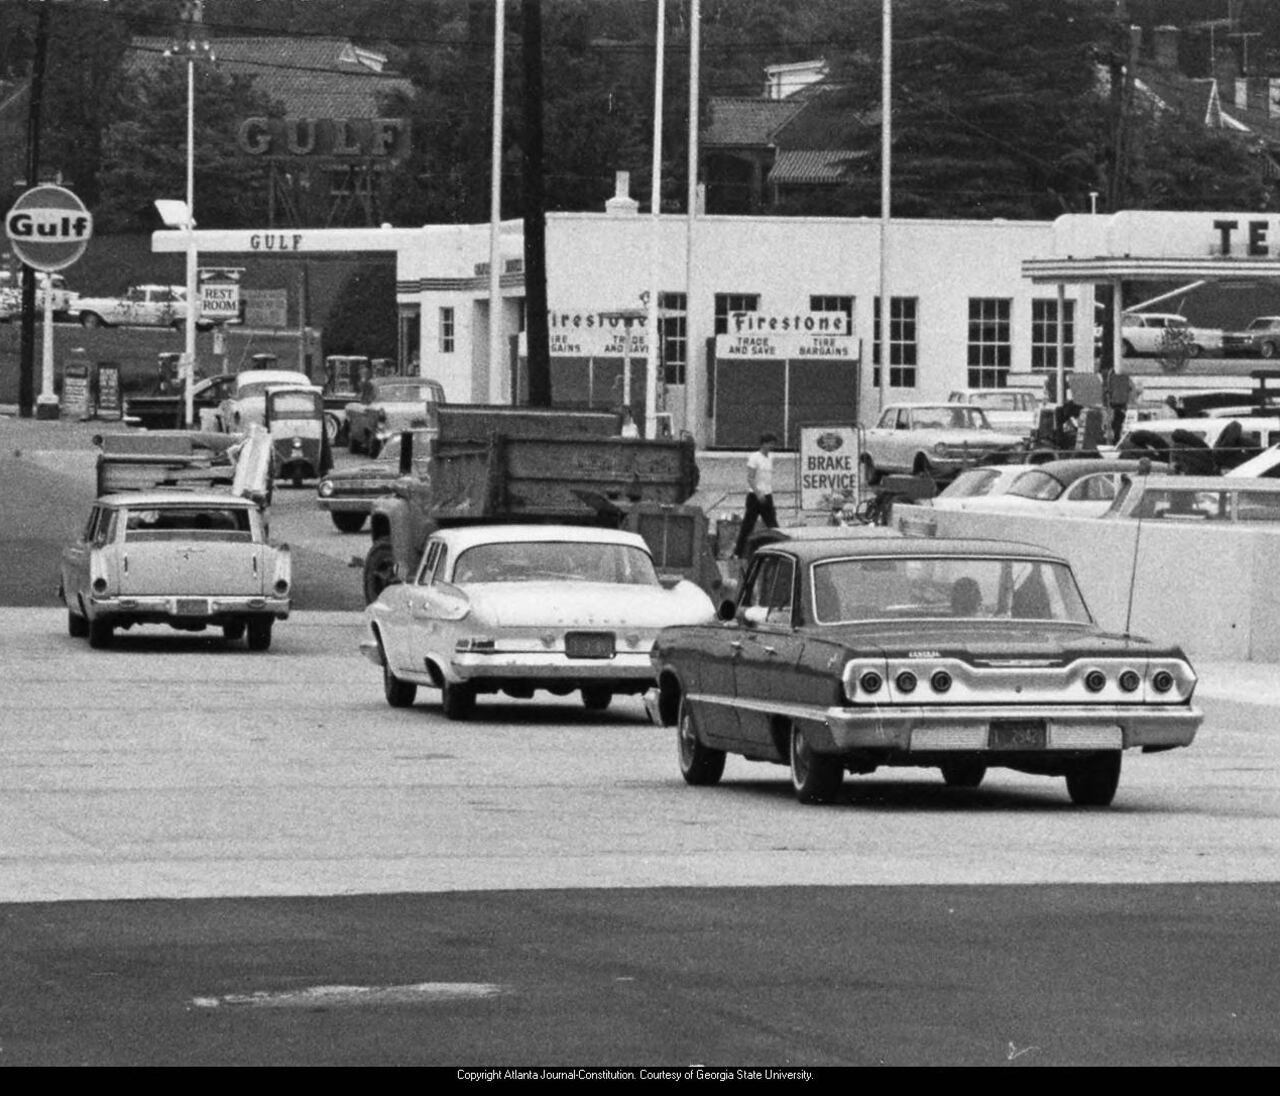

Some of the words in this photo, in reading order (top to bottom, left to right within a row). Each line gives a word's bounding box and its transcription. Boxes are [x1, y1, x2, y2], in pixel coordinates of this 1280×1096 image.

[238, 116, 403, 155] GULF
[9, 213, 87, 237] Gulf
[250, 235, 302, 250] GULF
[205, 288, 234, 299] REST
[203, 300, 237, 310] ROOM
[732, 312, 842, 331] Firestone
[612, 334, 644, 345] TRDE
[812, 337, 836, 347] TIRE
[728, 345, 748, 356] AND
[808, 455, 852, 471] BRAKE
[803, 474, 856, 489] SERVICE
